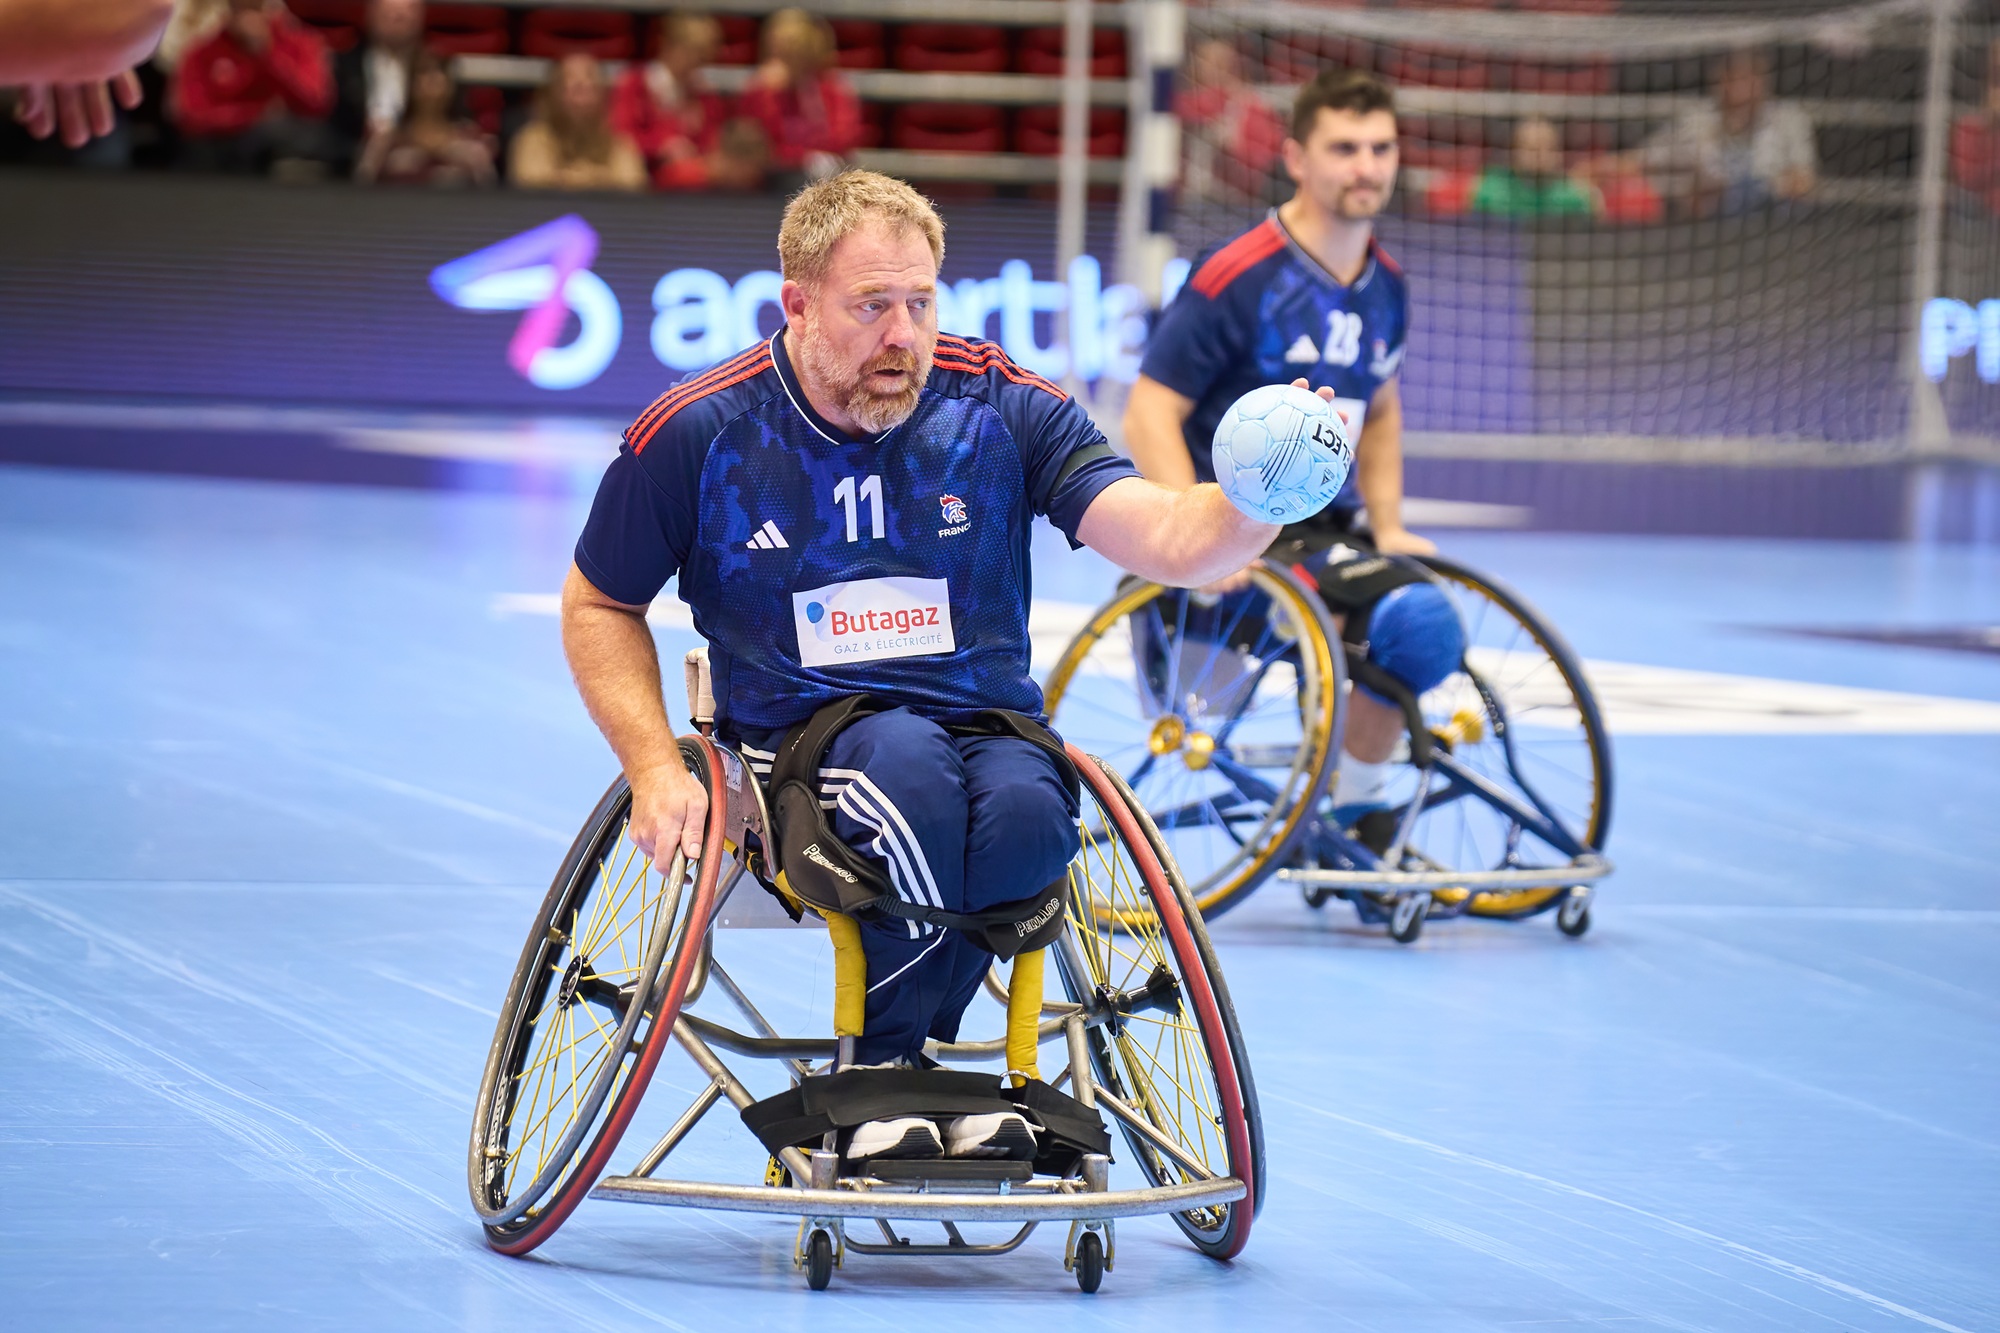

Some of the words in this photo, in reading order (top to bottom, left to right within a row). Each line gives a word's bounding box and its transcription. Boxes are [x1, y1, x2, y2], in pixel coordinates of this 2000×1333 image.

[833, 474, 885, 543] 11
[831, 606, 940, 636] Butagaz
[834, 643, 859, 655] GAZ
[864, 642, 872, 651] &
[876, 632, 943, 650] ÉLECTRICITÉ
